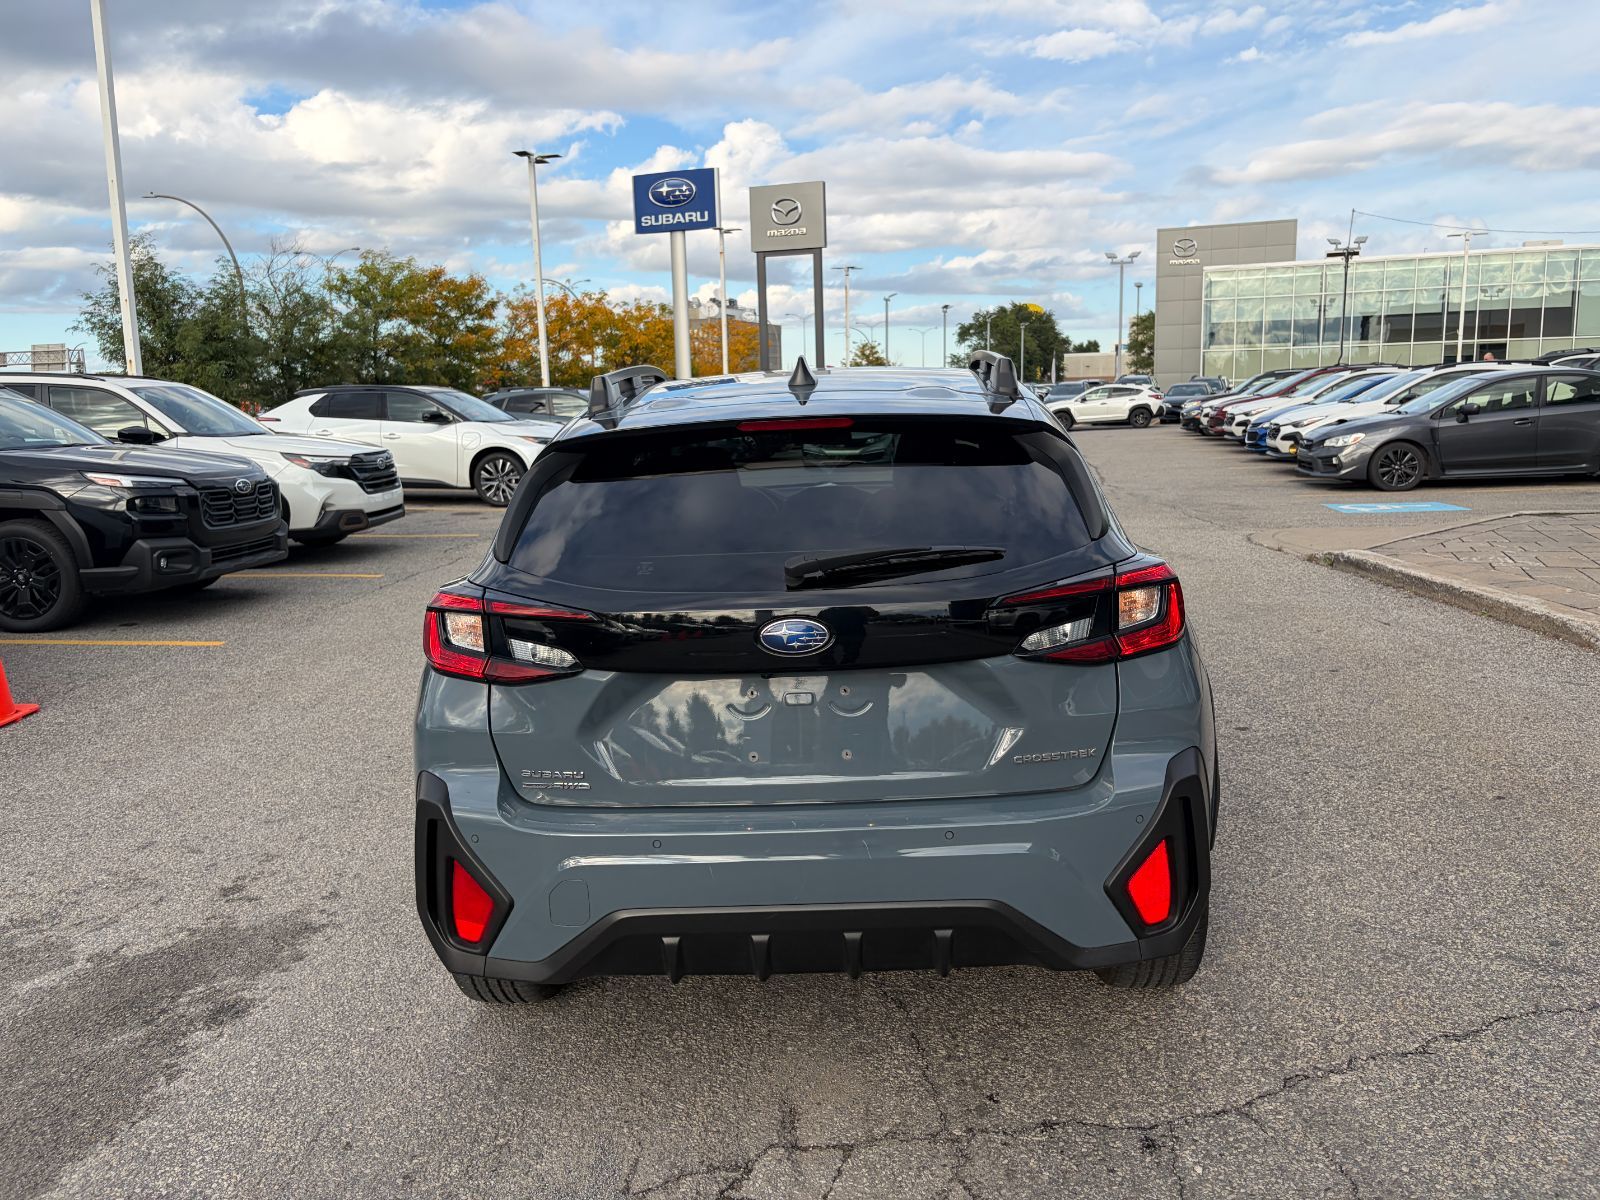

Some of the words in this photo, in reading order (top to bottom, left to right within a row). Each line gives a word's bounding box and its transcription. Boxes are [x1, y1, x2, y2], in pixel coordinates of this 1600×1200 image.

[641, 211, 709, 227] SUBARU
[767, 227, 807, 237] mazda
[1013, 747, 1097, 764] CROSSTREK
[521, 769, 584, 779] SUBARU
